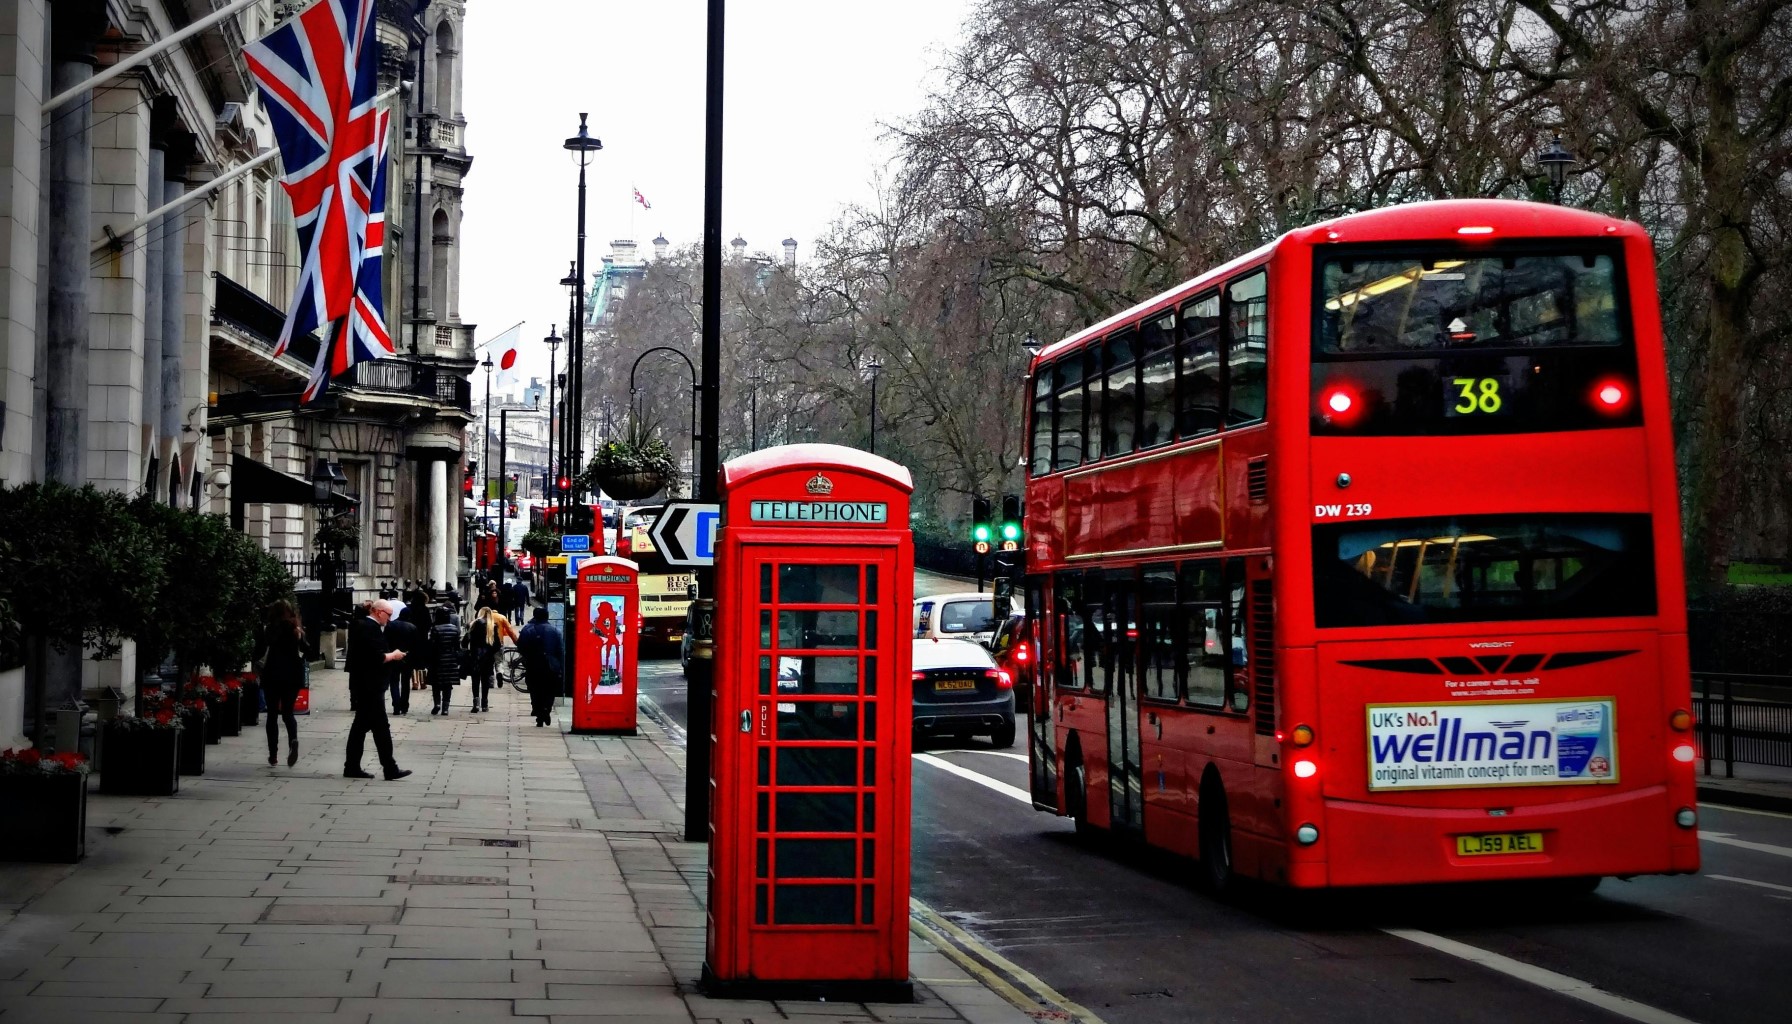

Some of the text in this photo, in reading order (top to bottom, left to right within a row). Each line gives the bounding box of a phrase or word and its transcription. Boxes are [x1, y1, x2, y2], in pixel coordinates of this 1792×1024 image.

[1453, 378, 1502, 414] 38
[756, 502, 882, 521] TELEPHONE
[1315, 503, 1372, 517] DW 239
[1373, 711, 1438, 728] UK's No.1
[1373, 718, 1553, 763] wellman
[1376, 762, 1555, 784] original vitamin concept for men
[1463, 835, 1537, 853] LJ59 AEL
